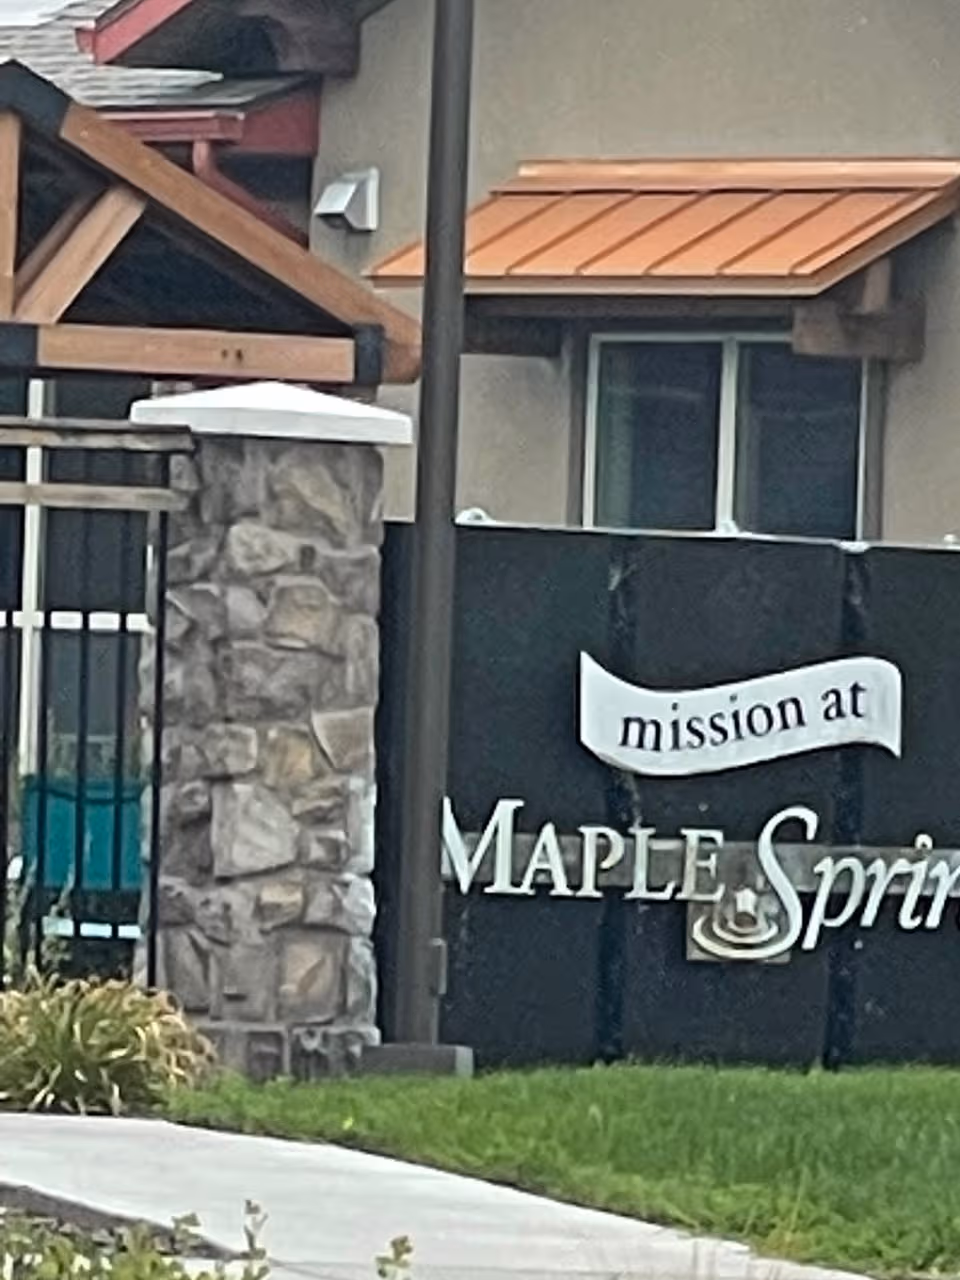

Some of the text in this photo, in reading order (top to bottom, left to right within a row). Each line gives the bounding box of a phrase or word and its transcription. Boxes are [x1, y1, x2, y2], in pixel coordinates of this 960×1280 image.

[618, 681, 868, 752] mission at
[442, 796, 725, 900] MAPLE
